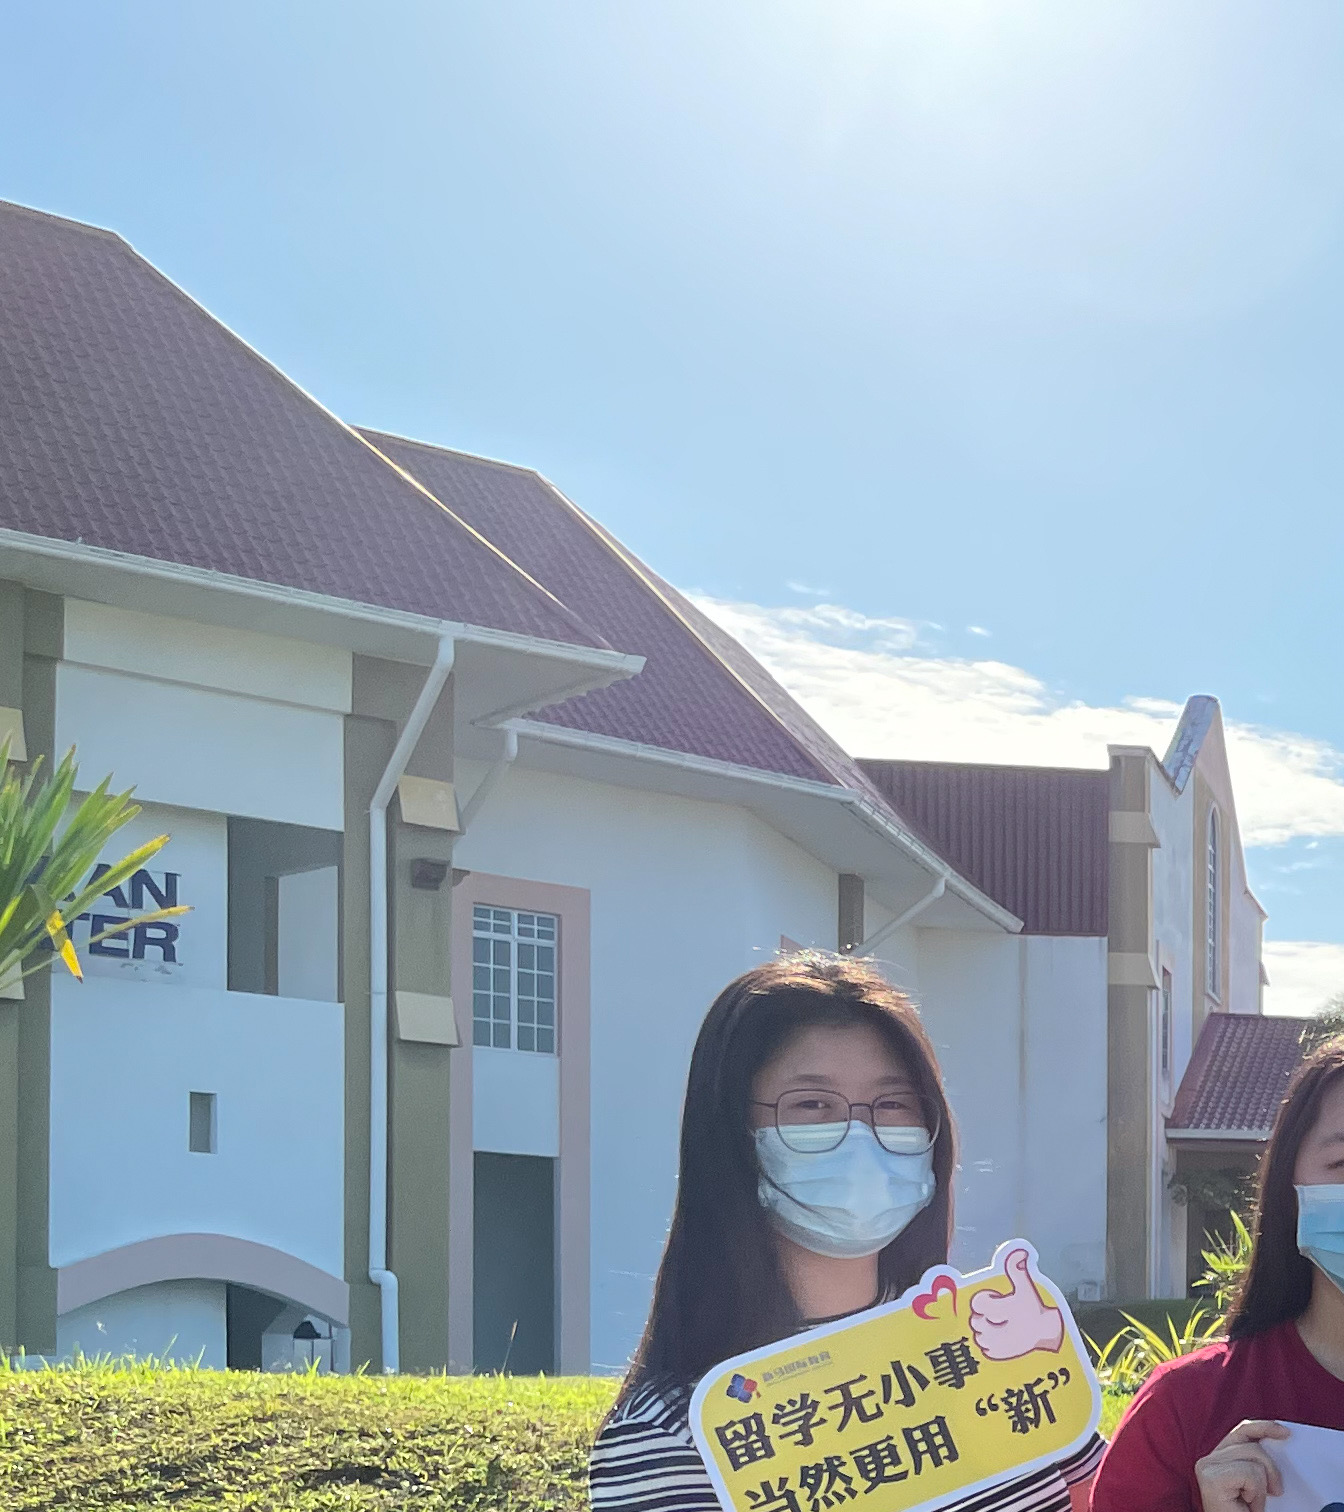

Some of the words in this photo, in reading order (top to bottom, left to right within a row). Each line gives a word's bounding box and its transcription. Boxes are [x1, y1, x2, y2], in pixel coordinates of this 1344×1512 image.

[64, 863, 179, 909] AN
[42, 912, 179, 963] TER
[715, 1335, 981, 1472] 留学无小事
